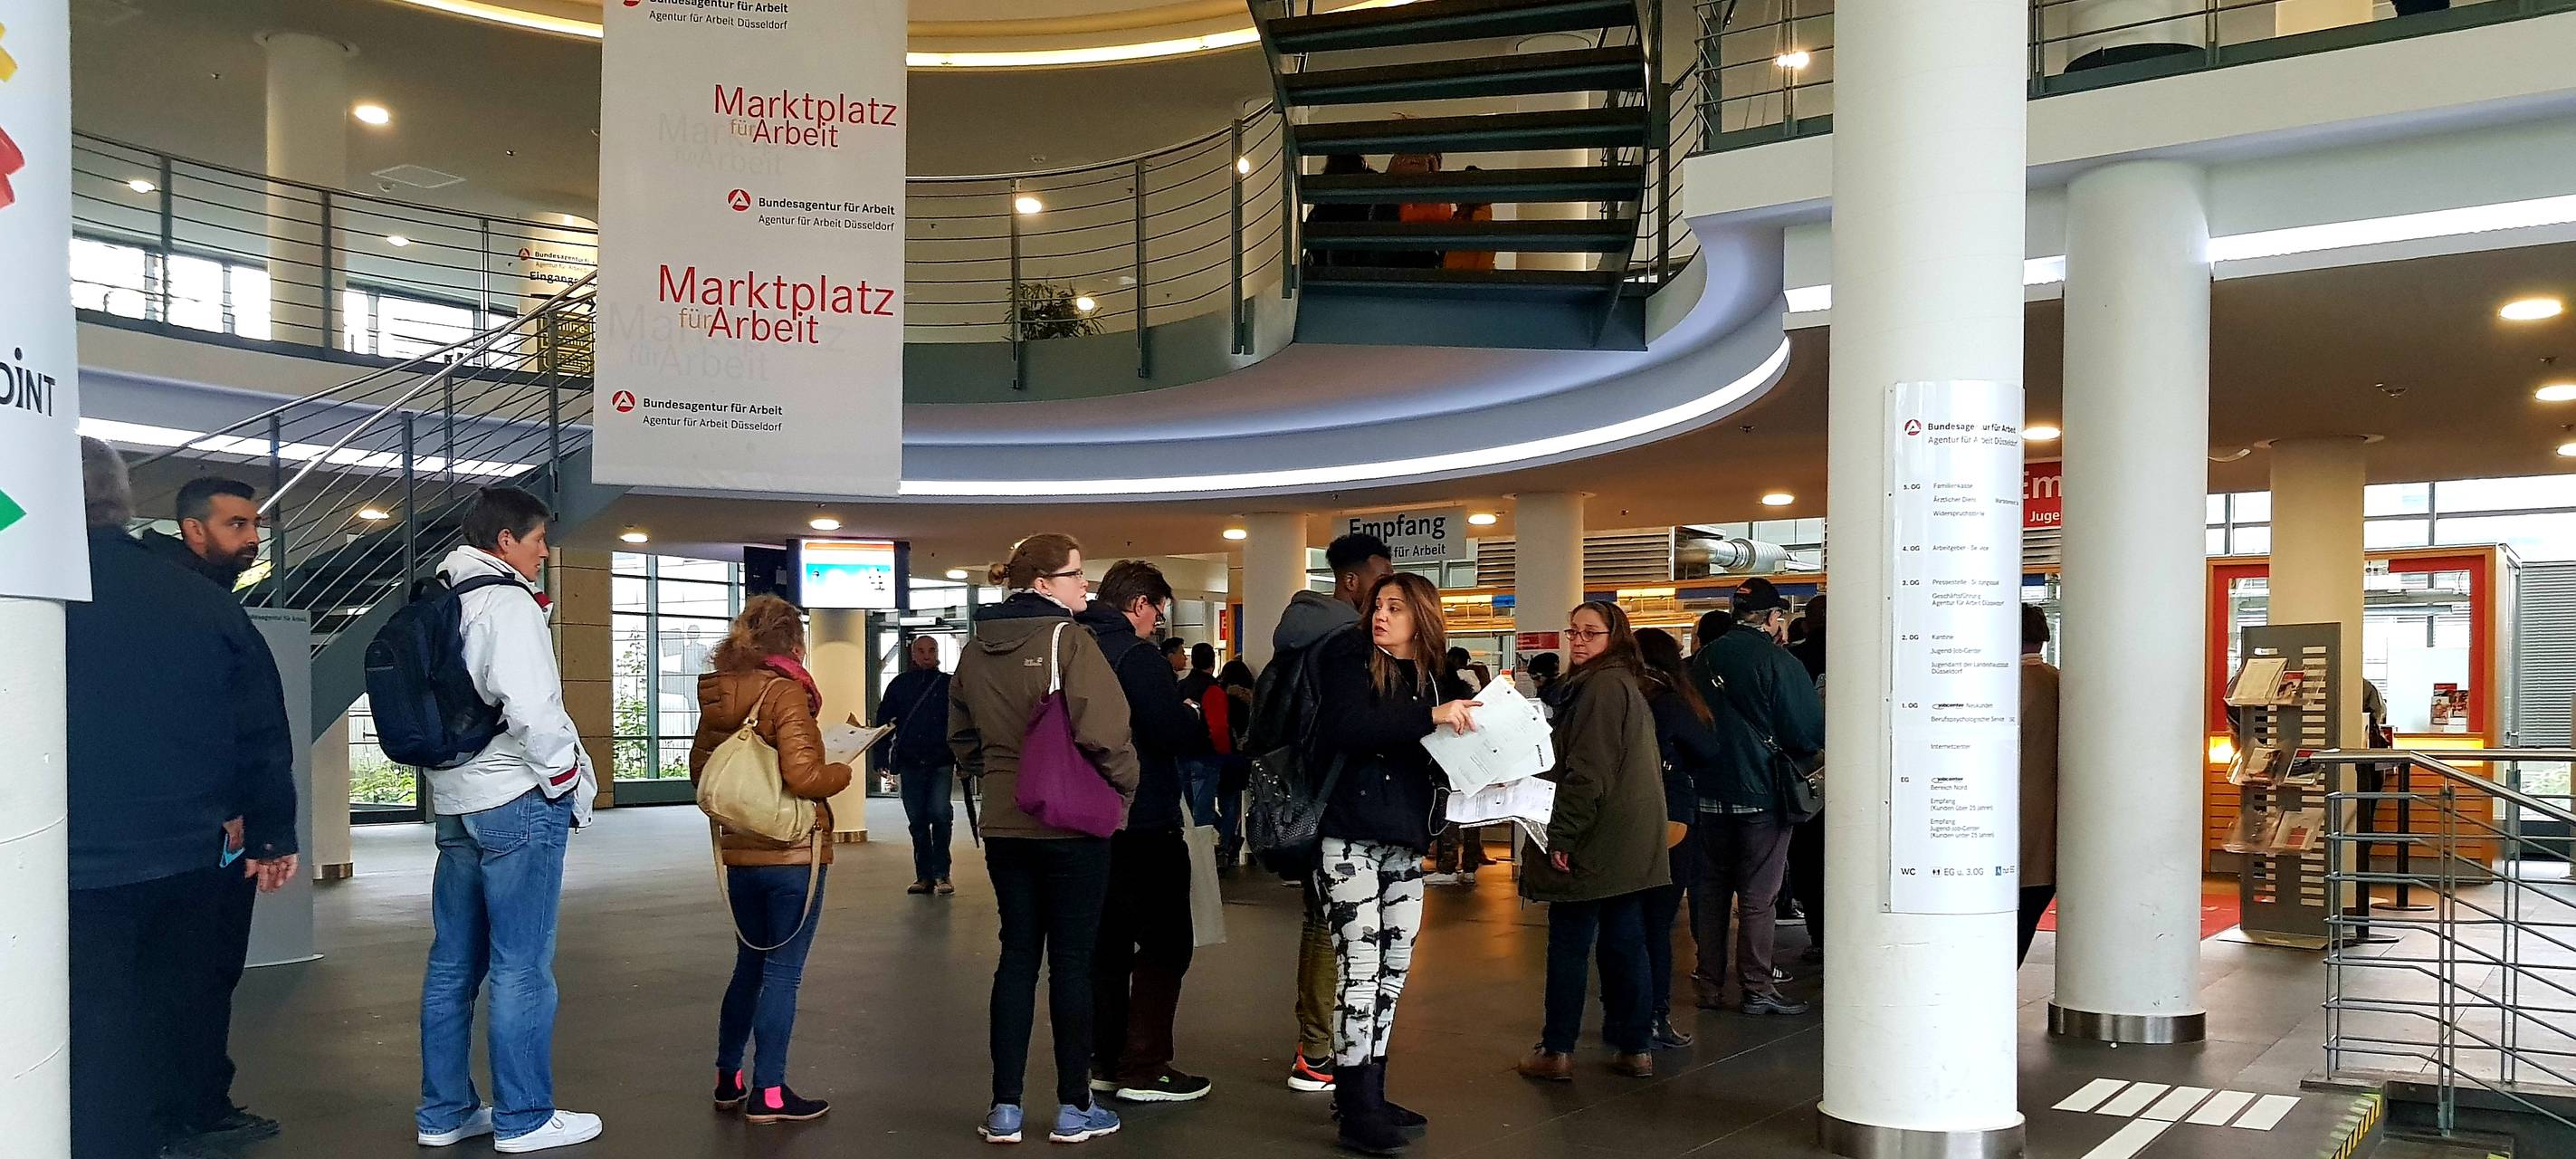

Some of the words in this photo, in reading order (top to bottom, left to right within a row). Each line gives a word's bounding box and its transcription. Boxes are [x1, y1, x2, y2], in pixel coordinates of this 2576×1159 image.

[650, 0, 735, 10] esagentur
[737, 0, 753, 12] für
[755, 3, 788, 14] Arbeit
[649, 10, 688, 23] Agentur
[690, 13, 703, 23] für
[706, 14, 734, 25] Arbeit
[737, 17, 788, 30] Düsseldorf
[714, 83, 899, 129] Marktplatz
[730, 119, 756, 137] für
[752, 118, 839, 148] Arbeit
[758, 197, 842, 213] Bundesagentur
[844, 201, 860, 214] für
[861, 203, 895, 216] Arbeit
[758, 215, 796, 226] Agentur
[797, 216, 811, 226] für
[813, 217, 842, 229] Arbeit
[844, 219, 895, 233] Düsseldorf
[659, 263, 895, 321] Marktplatz
[679, 307, 712, 330] für
[708, 306, 819, 345] Arbeit
[643, 398, 728, 414] Bundesagentur
[730, 401, 747, 414] für
[749, 403, 783, 417] Arbeit
[643, 415, 681, 428] Agentur
[682, 417, 698, 427] für
[699, 417, 728, 429] Arbeit
[730, 420, 783, 432] Düsseldorf
[1927, 422, 1990, 434] Bundesageur
[1991, 423, 2001, 434] für
[1928, 436, 1960, 445] Agentur
[1961, 436, 1971, 444] für
[1973, 436, 1993, 445] Abeit
[2029, 511, 2060, 524] Juge
[1349, 513, 1446, 543] Empfang
[1394, 546, 1410, 558] für
[1412, 543, 1446, 557] Arbeit
[1901, 867, 1916, 876] WC
[1943, 867, 1955, 876] EG
